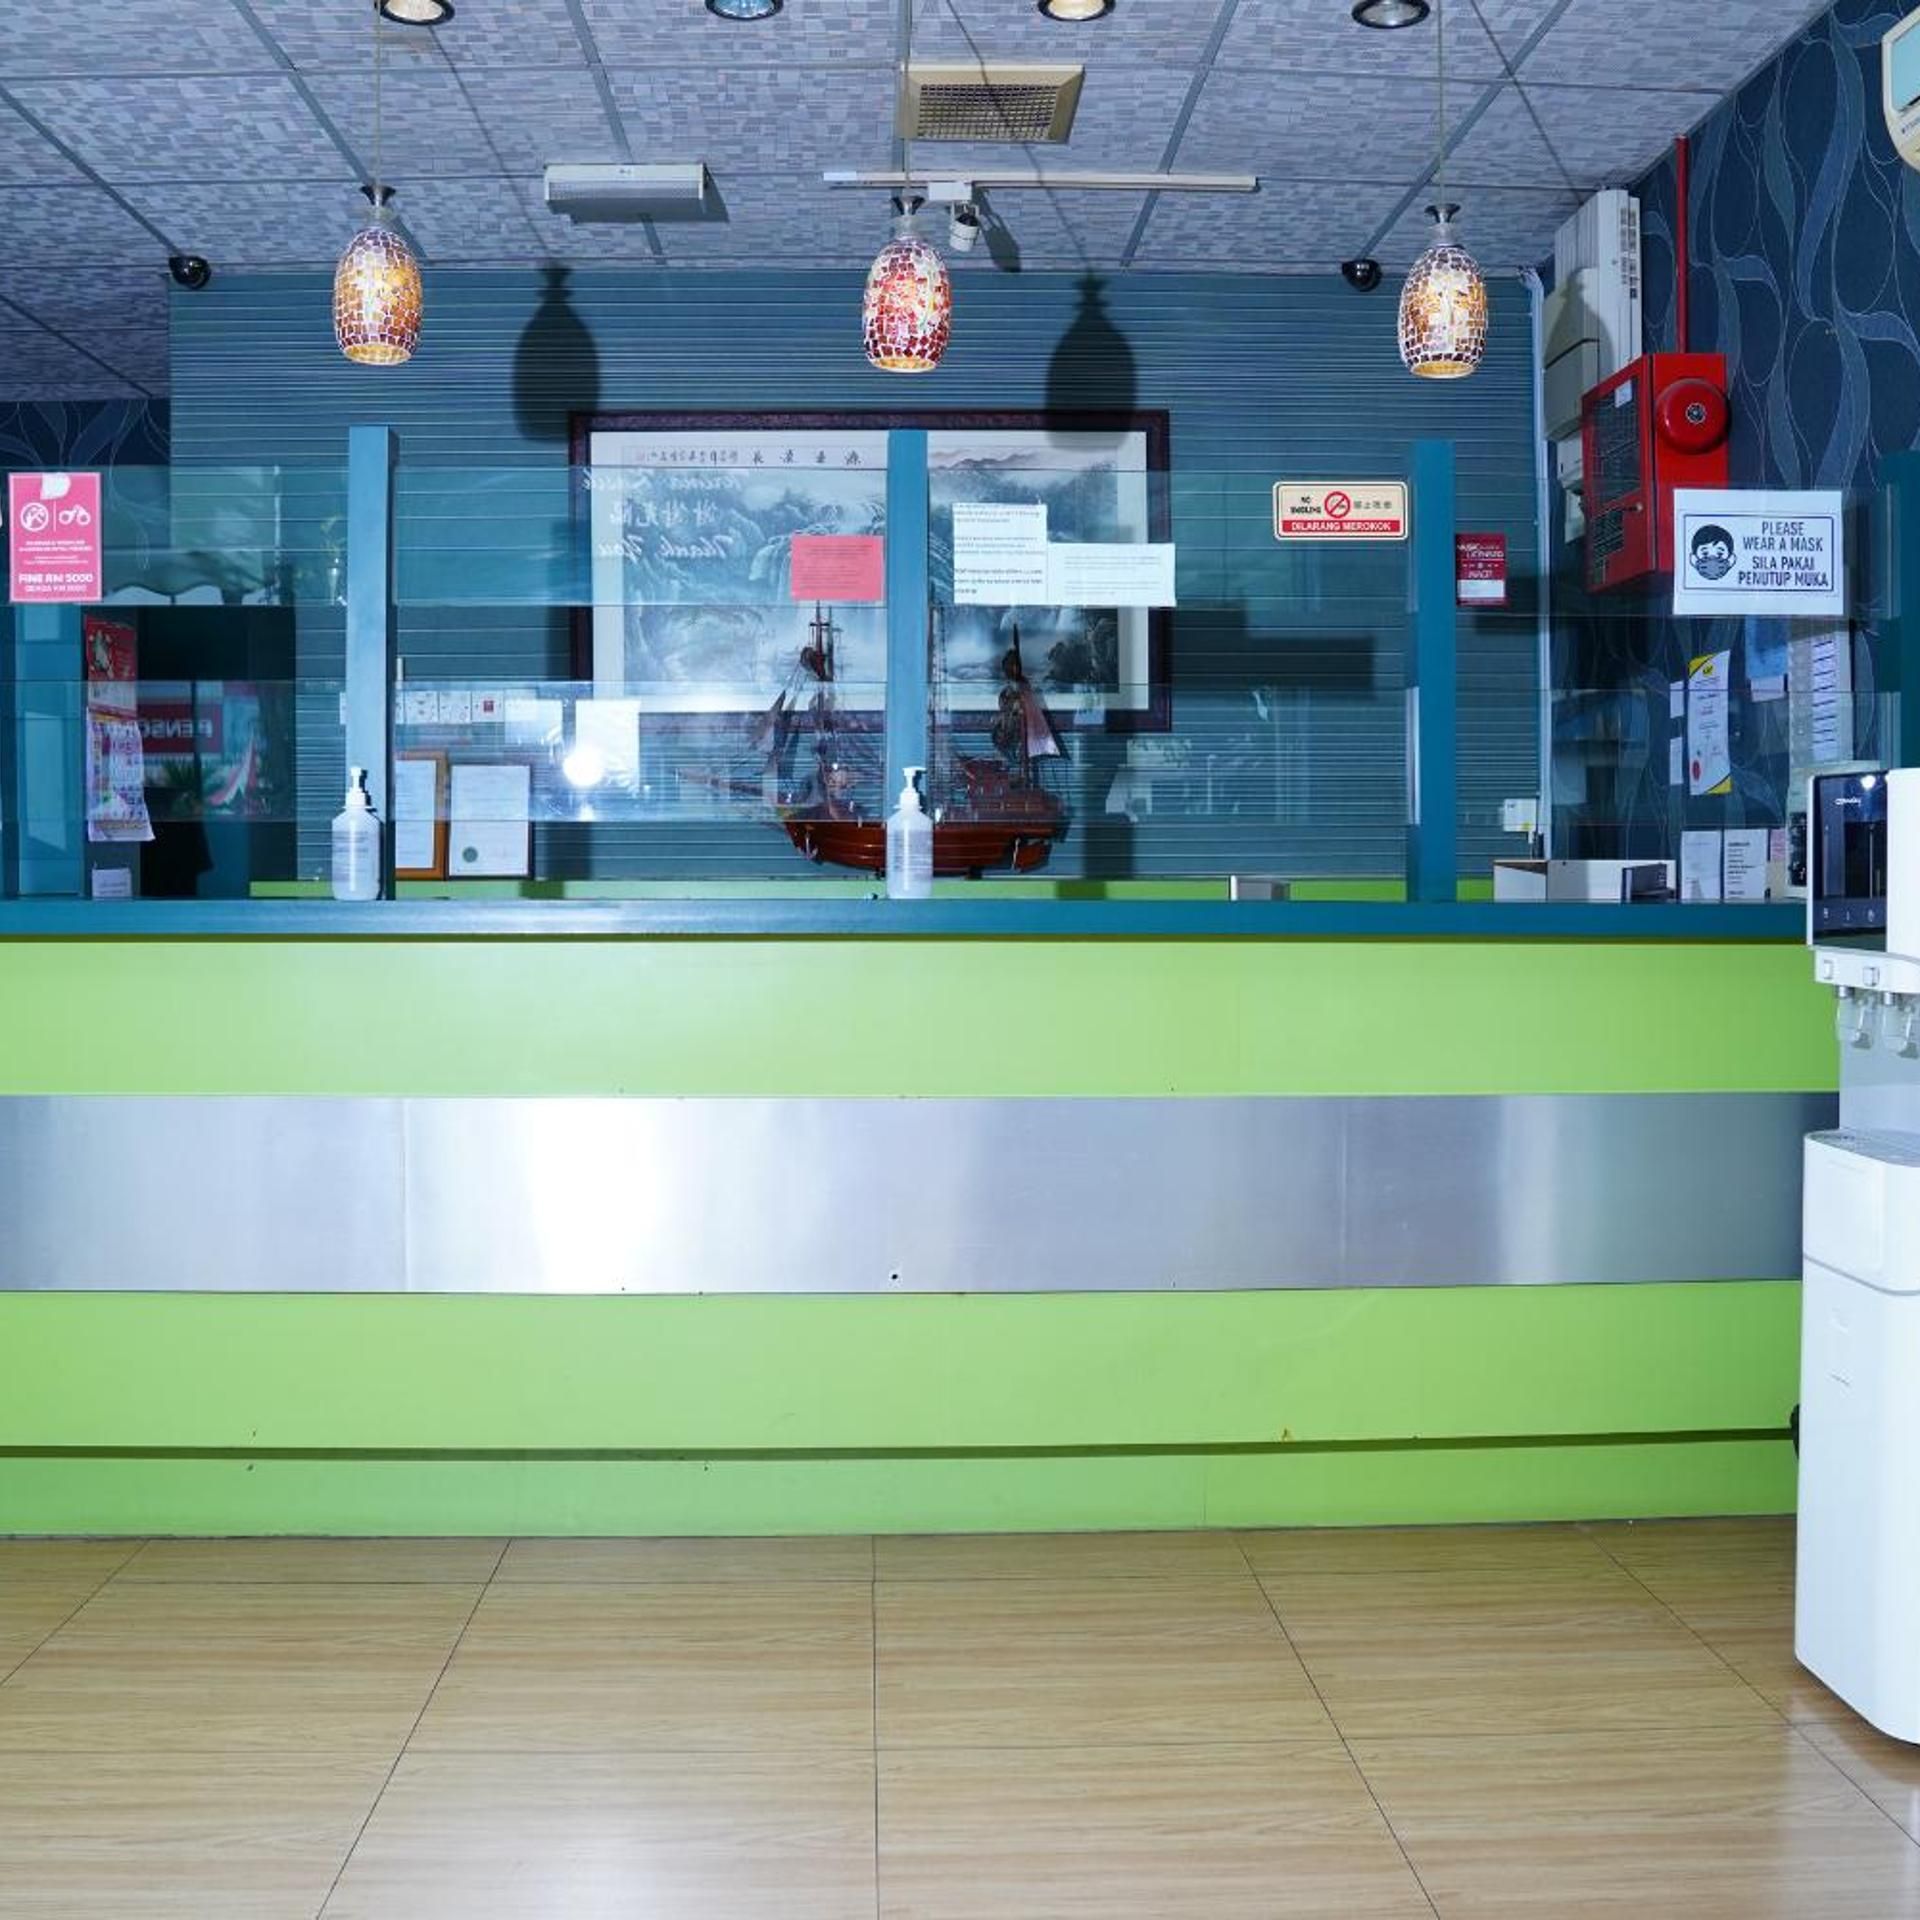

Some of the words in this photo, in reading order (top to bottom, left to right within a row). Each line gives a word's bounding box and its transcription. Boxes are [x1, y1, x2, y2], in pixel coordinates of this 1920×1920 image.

[1291, 521, 1341, 531] DILARANG
[1342, 521, 1391, 531] MEROKOK
[1761, 521, 1806, 536] PLEASE
[1743, 536, 1775, 551] WEAR
[1778, 537, 1787, 551] A
[1790, 537, 1823, 552] MASK
[1752, 556, 1777, 569] SILA
[1780, 556, 1816, 570] PAKAI
[1738, 571, 1791, 586] PENUTUP
[1794, 572, 1829, 587] MUKA
